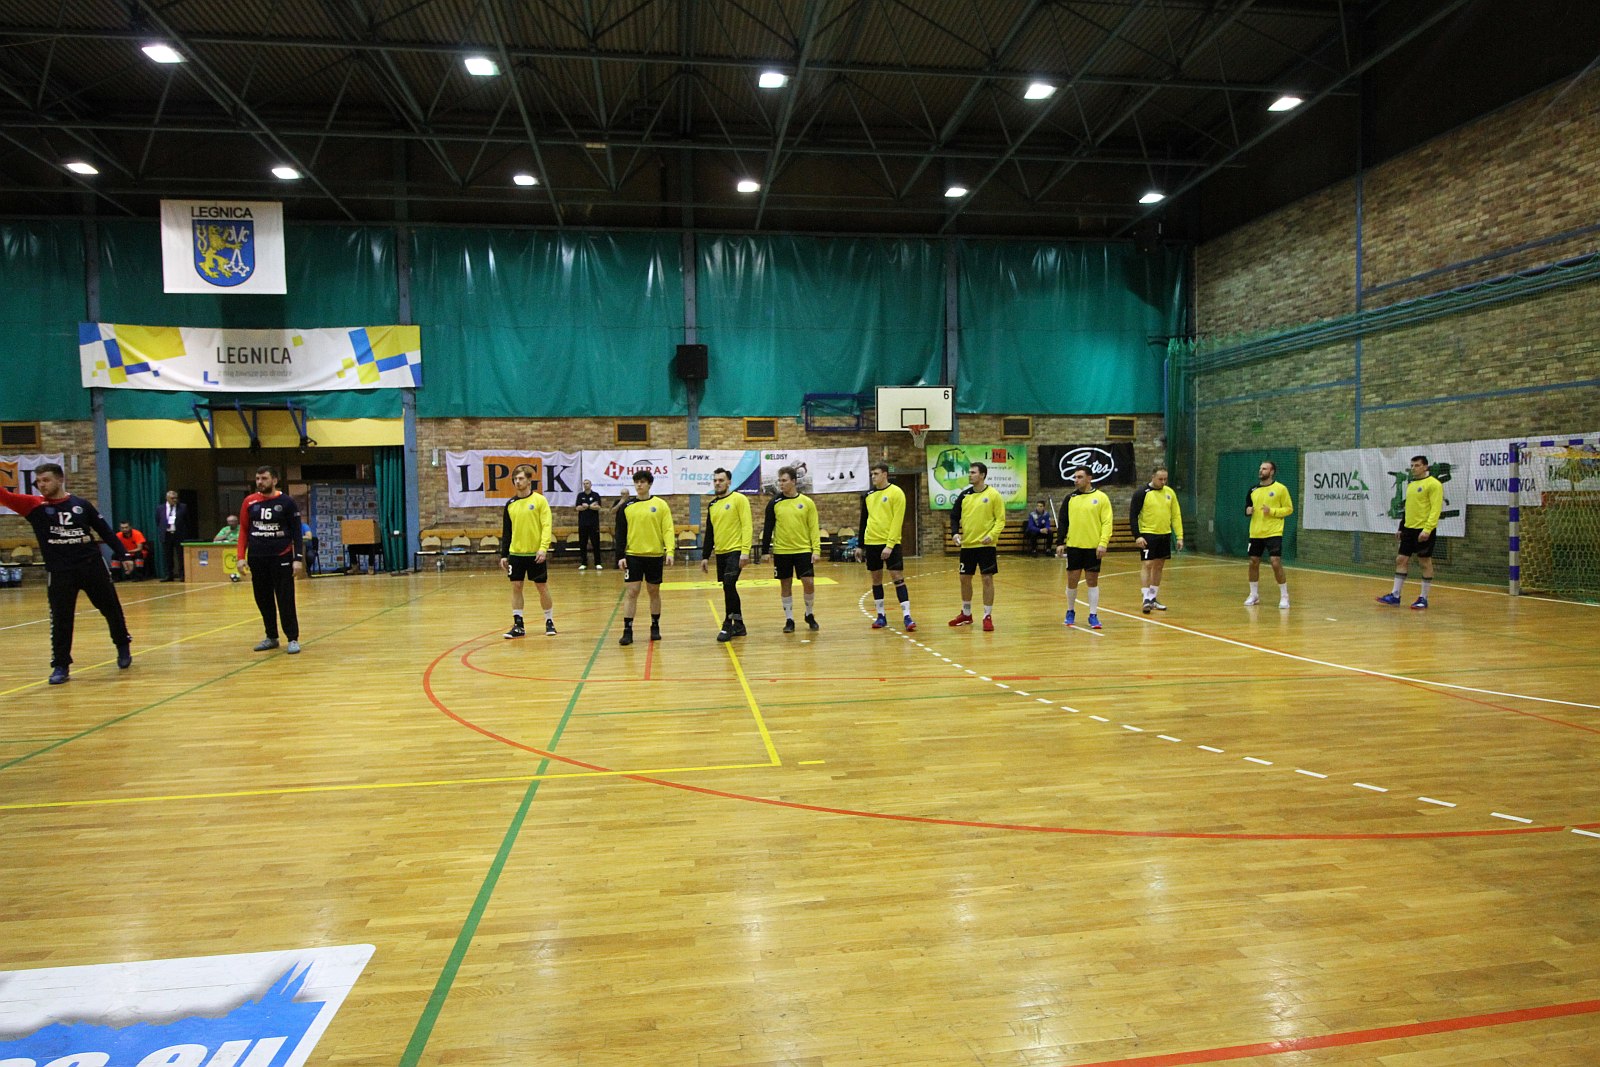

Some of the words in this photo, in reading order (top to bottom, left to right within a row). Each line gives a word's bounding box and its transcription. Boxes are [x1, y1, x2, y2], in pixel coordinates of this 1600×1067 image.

[191, 206, 253, 219] LEGNICA
[217, 347, 292, 364] LEGNICA
[943, 390, 949, 400] 6
[1480, 452, 1532, 467] GENERNY
[1314, 472, 1352, 489] SARIV
[1475, 478, 1536, 492] WYKONWCA
[57, 511, 73, 526] 12
[261, 507, 272, 520] 16
[1143, 549, 1149, 559] 7
